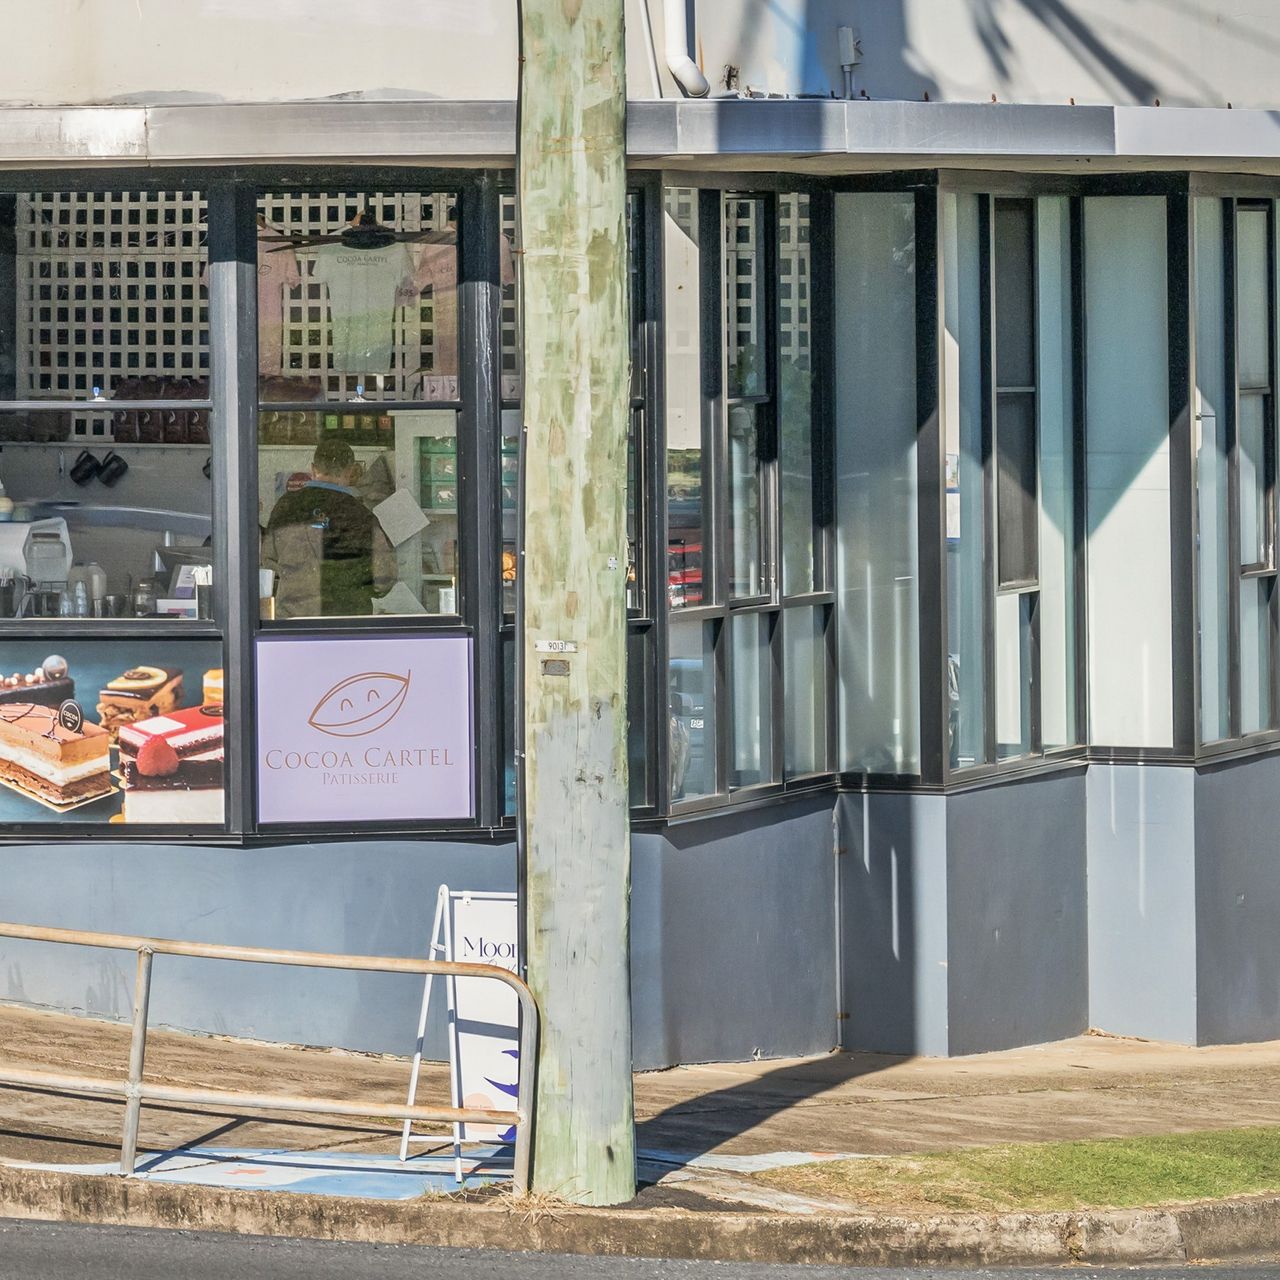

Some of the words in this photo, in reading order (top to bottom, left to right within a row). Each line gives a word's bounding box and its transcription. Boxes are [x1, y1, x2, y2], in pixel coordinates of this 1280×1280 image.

[63, 710, 79, 721] COCOA
[265, 749, 354, 770] COCOA
[364, 747, 454, 768] CARTEL
[322, 772, 399, 785] PATISSERIE
